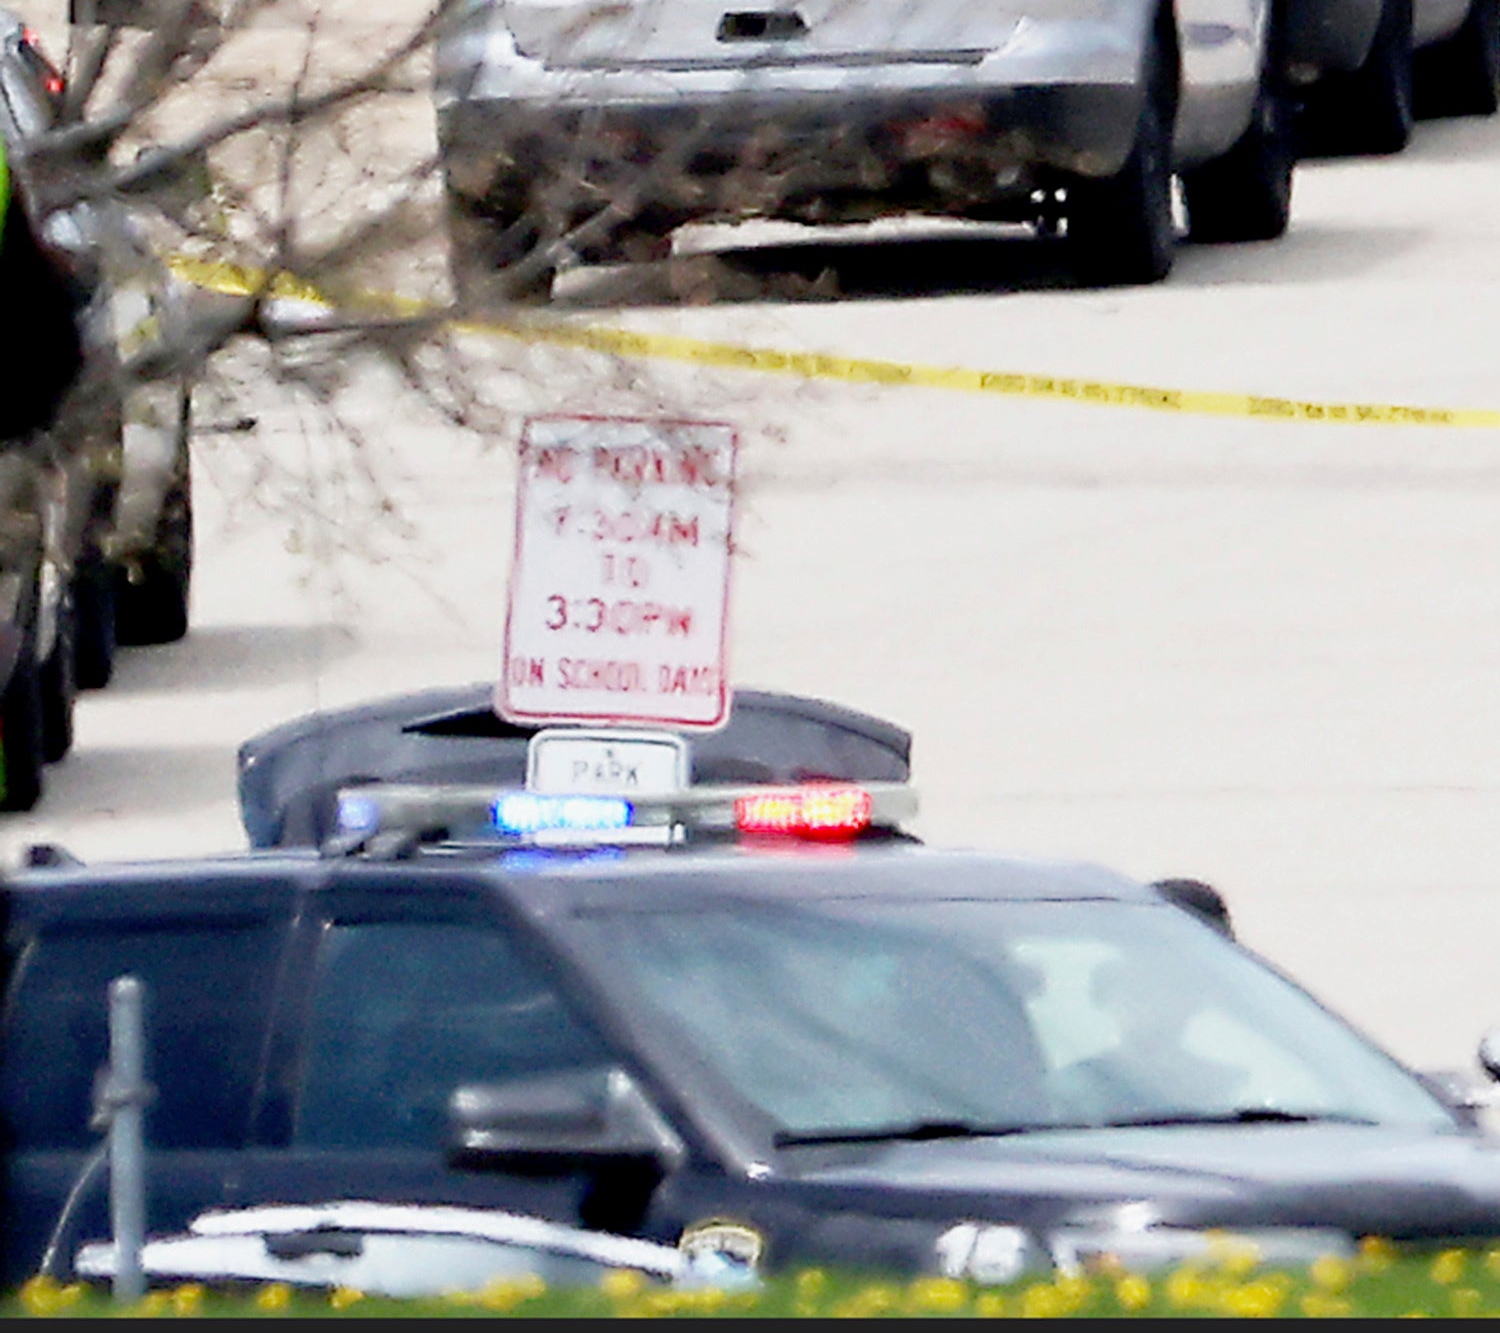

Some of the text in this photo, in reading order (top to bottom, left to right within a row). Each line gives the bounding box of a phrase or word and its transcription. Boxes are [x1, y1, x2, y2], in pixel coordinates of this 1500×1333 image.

[602, 553, 649, 587] TO
[545, 594, 692, 638] 3:30PM
[511, 655, 546, 687] ON
[557, 656, 643, 692] SCHOOL
[573, 759, 639, 785] PARK
